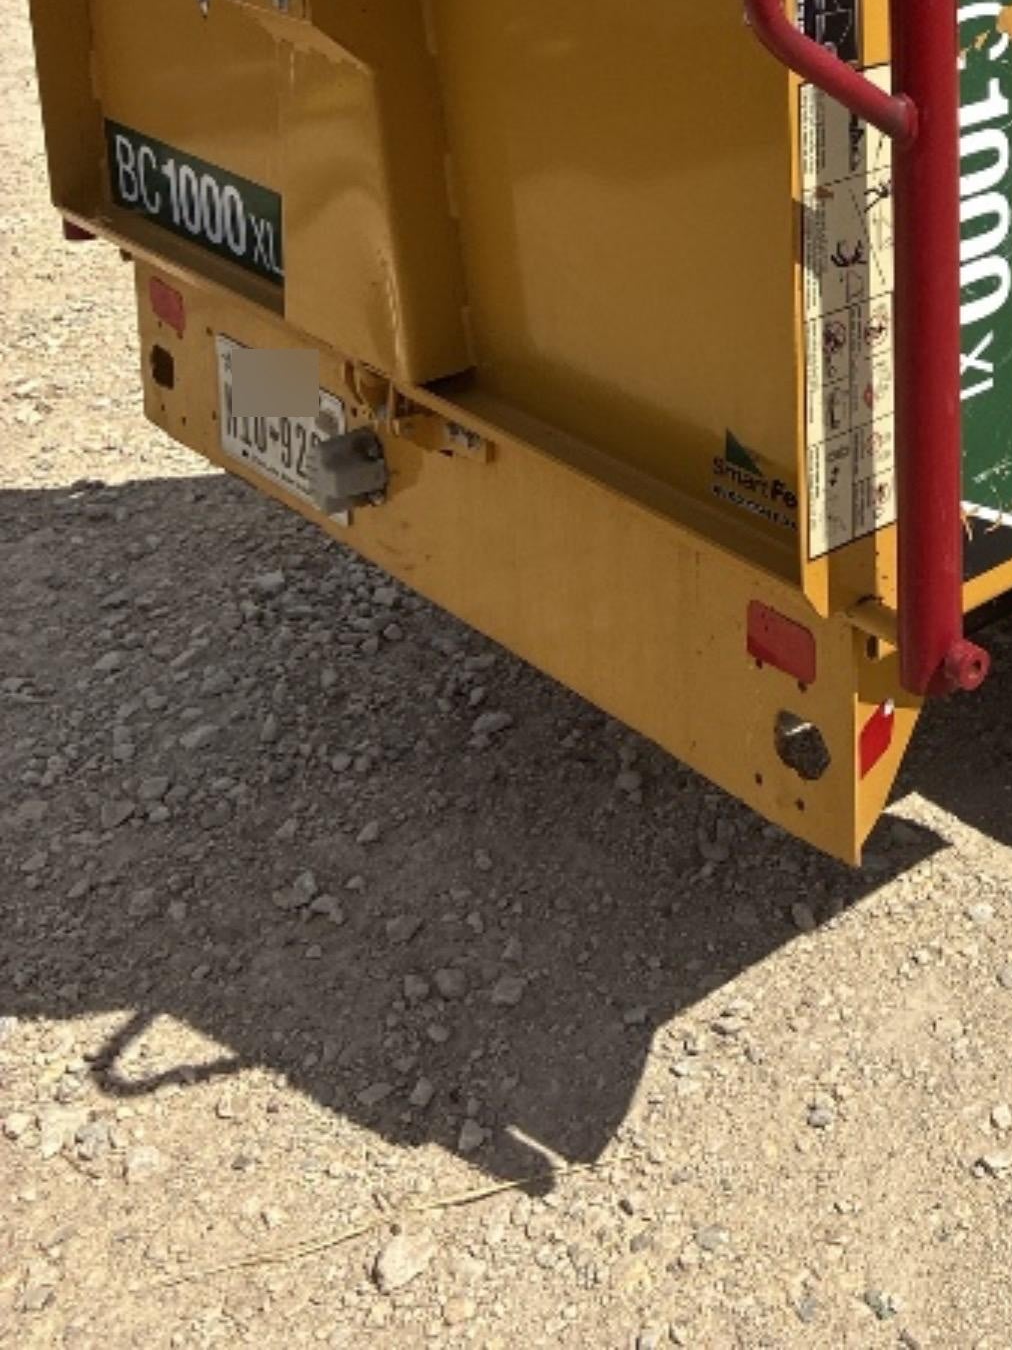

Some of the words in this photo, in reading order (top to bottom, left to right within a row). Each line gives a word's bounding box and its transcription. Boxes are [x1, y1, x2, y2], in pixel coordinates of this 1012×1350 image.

[115, 133, 161, 215] BC
[160, 158, 247, 257] 1000
[956, 78, 1012, 326] 1000
